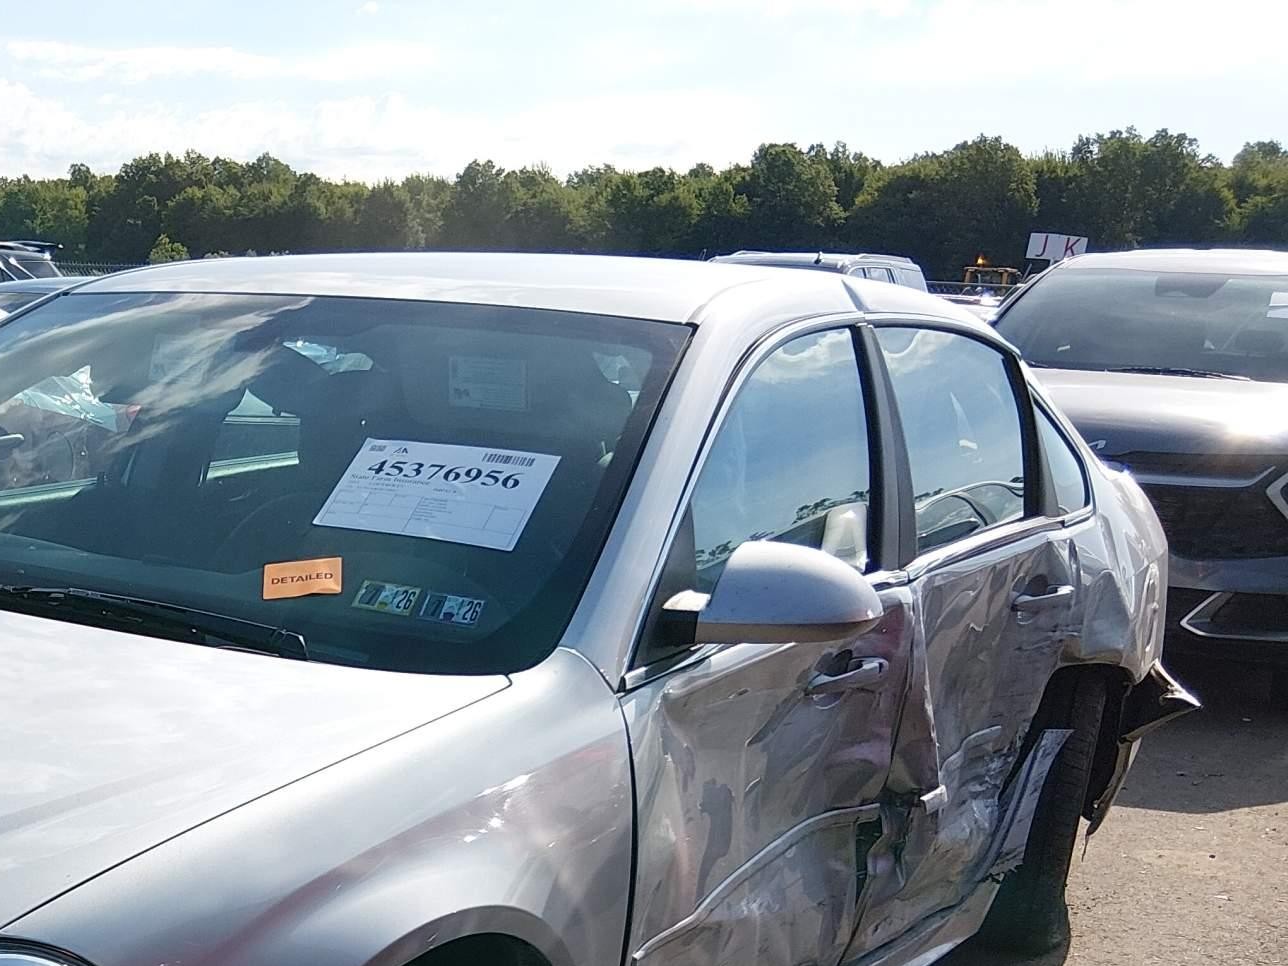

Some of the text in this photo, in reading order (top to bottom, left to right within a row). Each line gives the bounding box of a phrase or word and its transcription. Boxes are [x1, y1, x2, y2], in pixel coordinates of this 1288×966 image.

[1035, 235, 1081, 257] J K
[367, 459, 525, 490] 45376956
[271, 572, 334, 585] DETAILED
